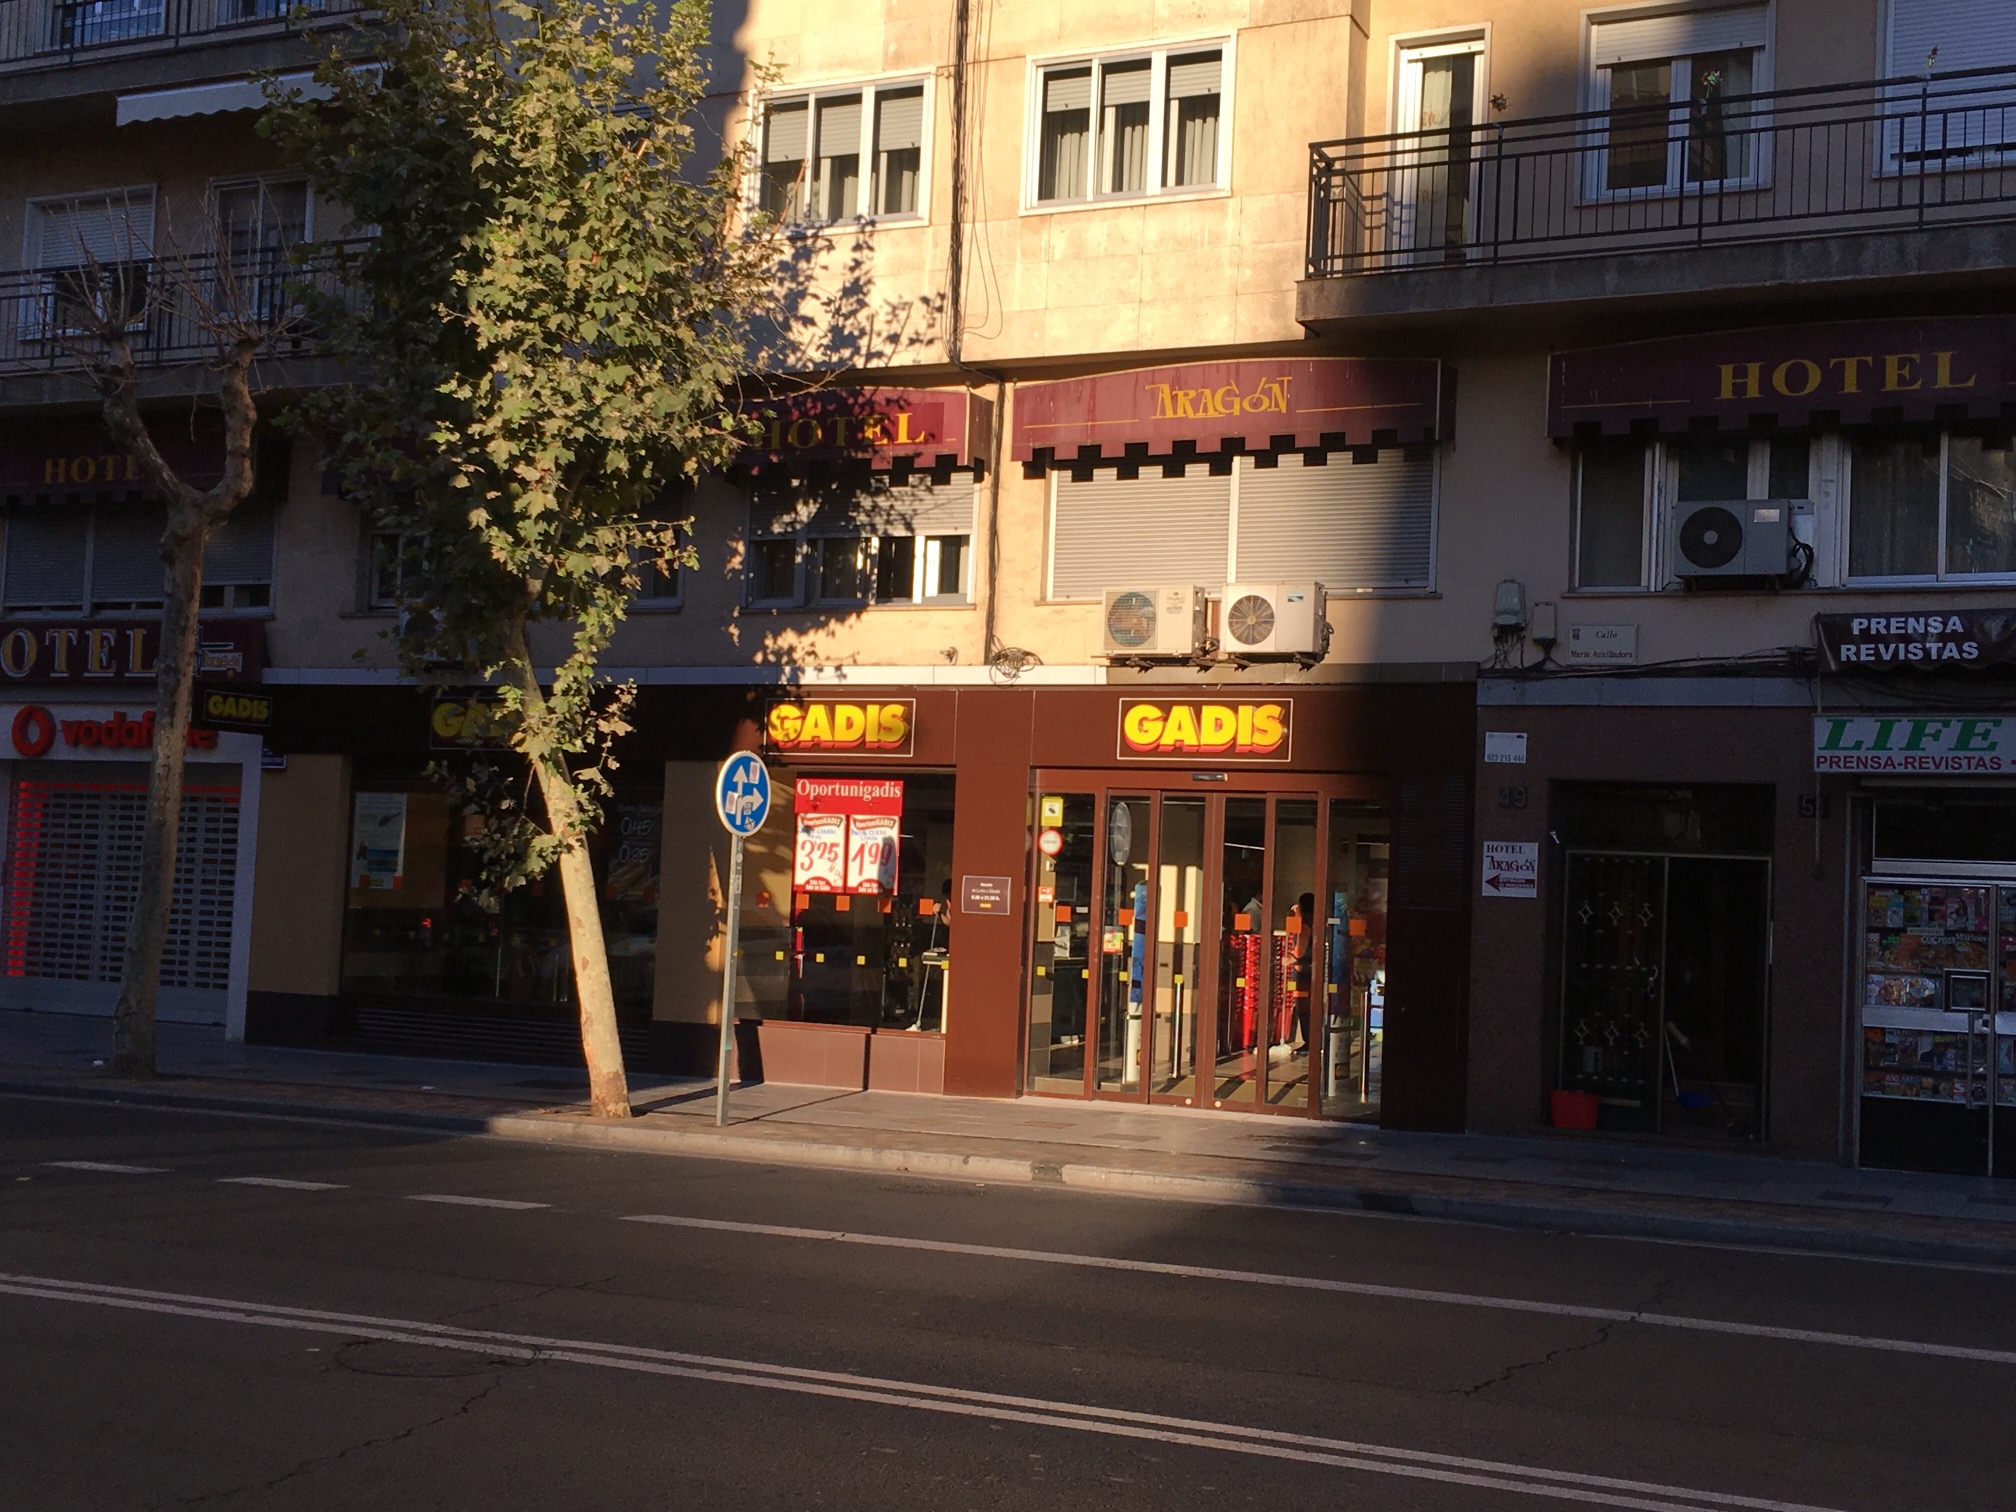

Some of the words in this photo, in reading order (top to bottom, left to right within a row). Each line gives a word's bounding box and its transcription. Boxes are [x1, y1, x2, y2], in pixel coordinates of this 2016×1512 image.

[1714, 351, 1976, 400] HOTEL
[1145, 377, 1292, 419] ARAGÓN
[750, 411, 926, 450] HOTEL
[1596, 630, 1618, 639] Calle
[1852, 616, 1964, 635] PRENSA
[1840, 642, 1979, 661] REVISTAS
[207, 694, 270, 721] GADIS
[60, 711, 219, 748] vodafe
[767, 704, 909, 748] GADIS
[1123, 704, 1287, 753] GADIS
[1818, 719, 2003, 751] LIFE
[1816, 755, 2002, 771] PRENSA-REVISTAS
[797, 779, 902, 801] Oportunigadis
[1500, 787, 1527, 807] 49
[1486, 844, 1526, 854] HOTEL
